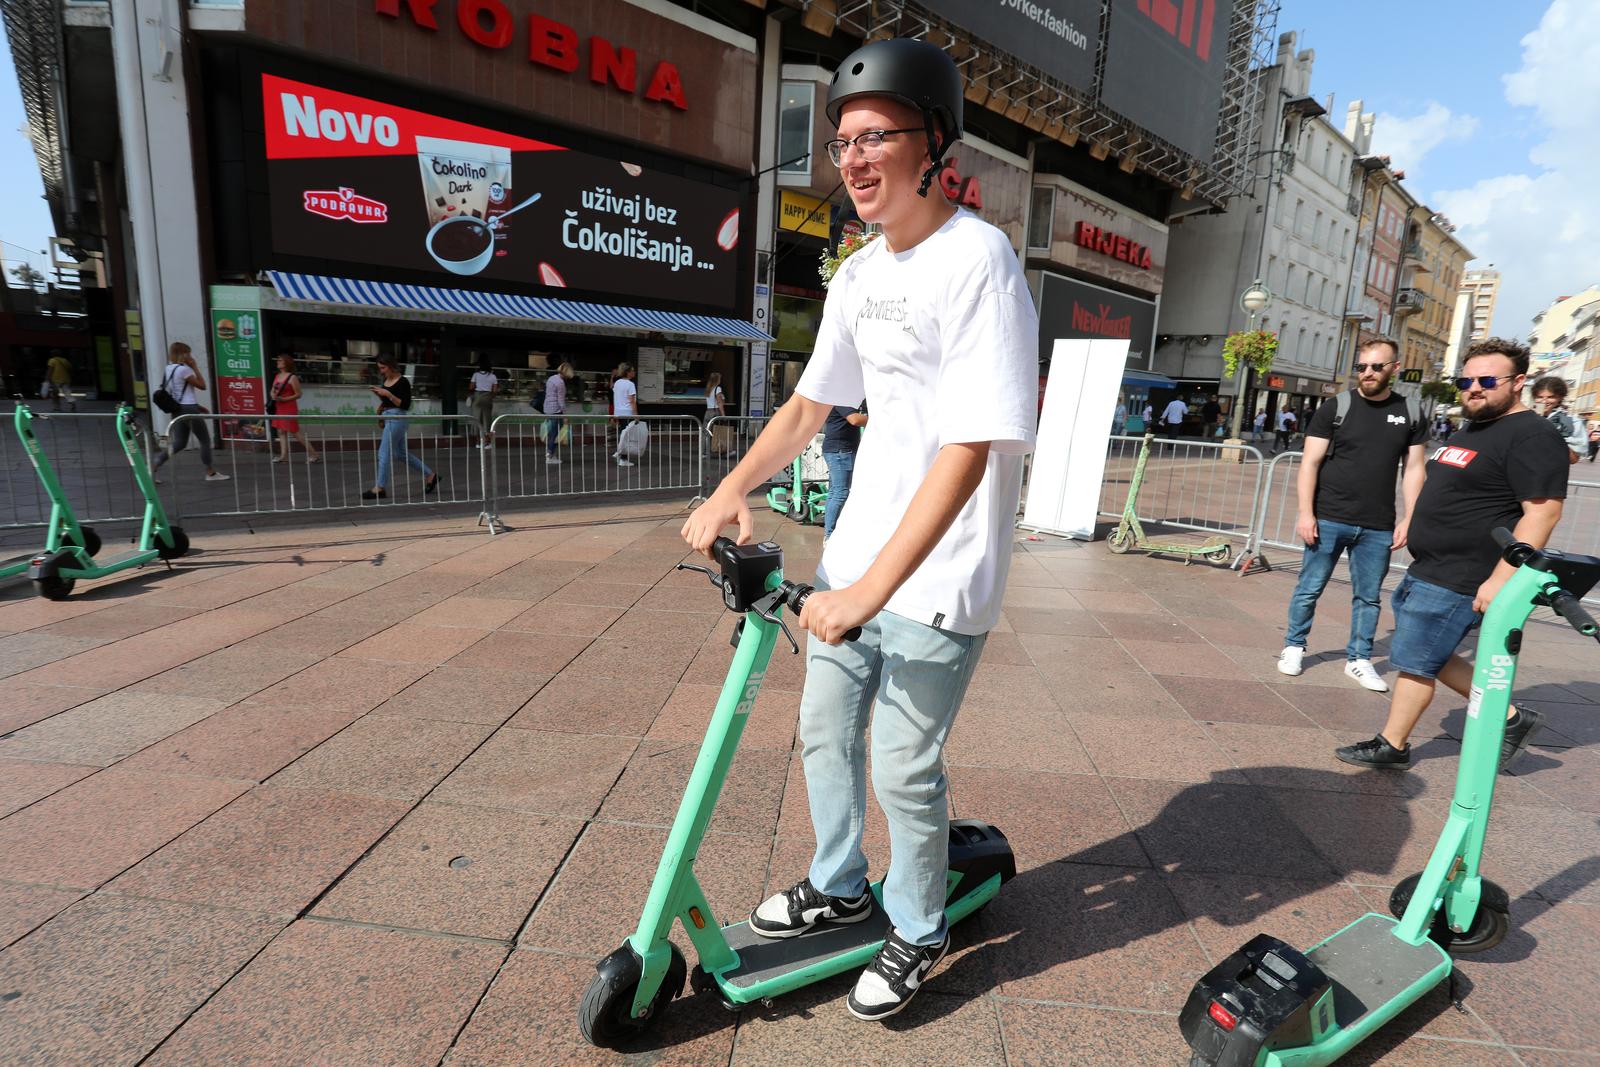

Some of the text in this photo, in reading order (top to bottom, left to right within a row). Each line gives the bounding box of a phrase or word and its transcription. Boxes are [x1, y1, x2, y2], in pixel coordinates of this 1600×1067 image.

[1000, 0, 1088, 50] rker.fashion
[448, 180, 473, 194] Dark
[938, 156, 983, 210] ĆA
[311, 196, 383, 218] PODRAVKA
[581, 186, 678, 226] uživaj bez
[784, 203, 807, 220] HAPPY
[562, 209, 694, 272] Čokolišanja
[1075, 220, 1153, 271] RIJEKA
[226, 358, 251, 370] Grill
[1387, 414, 1406, 425] Bolt
[1482, 654, 1515, 691] Bolt
[735, 671, 764, 715] Bolt
